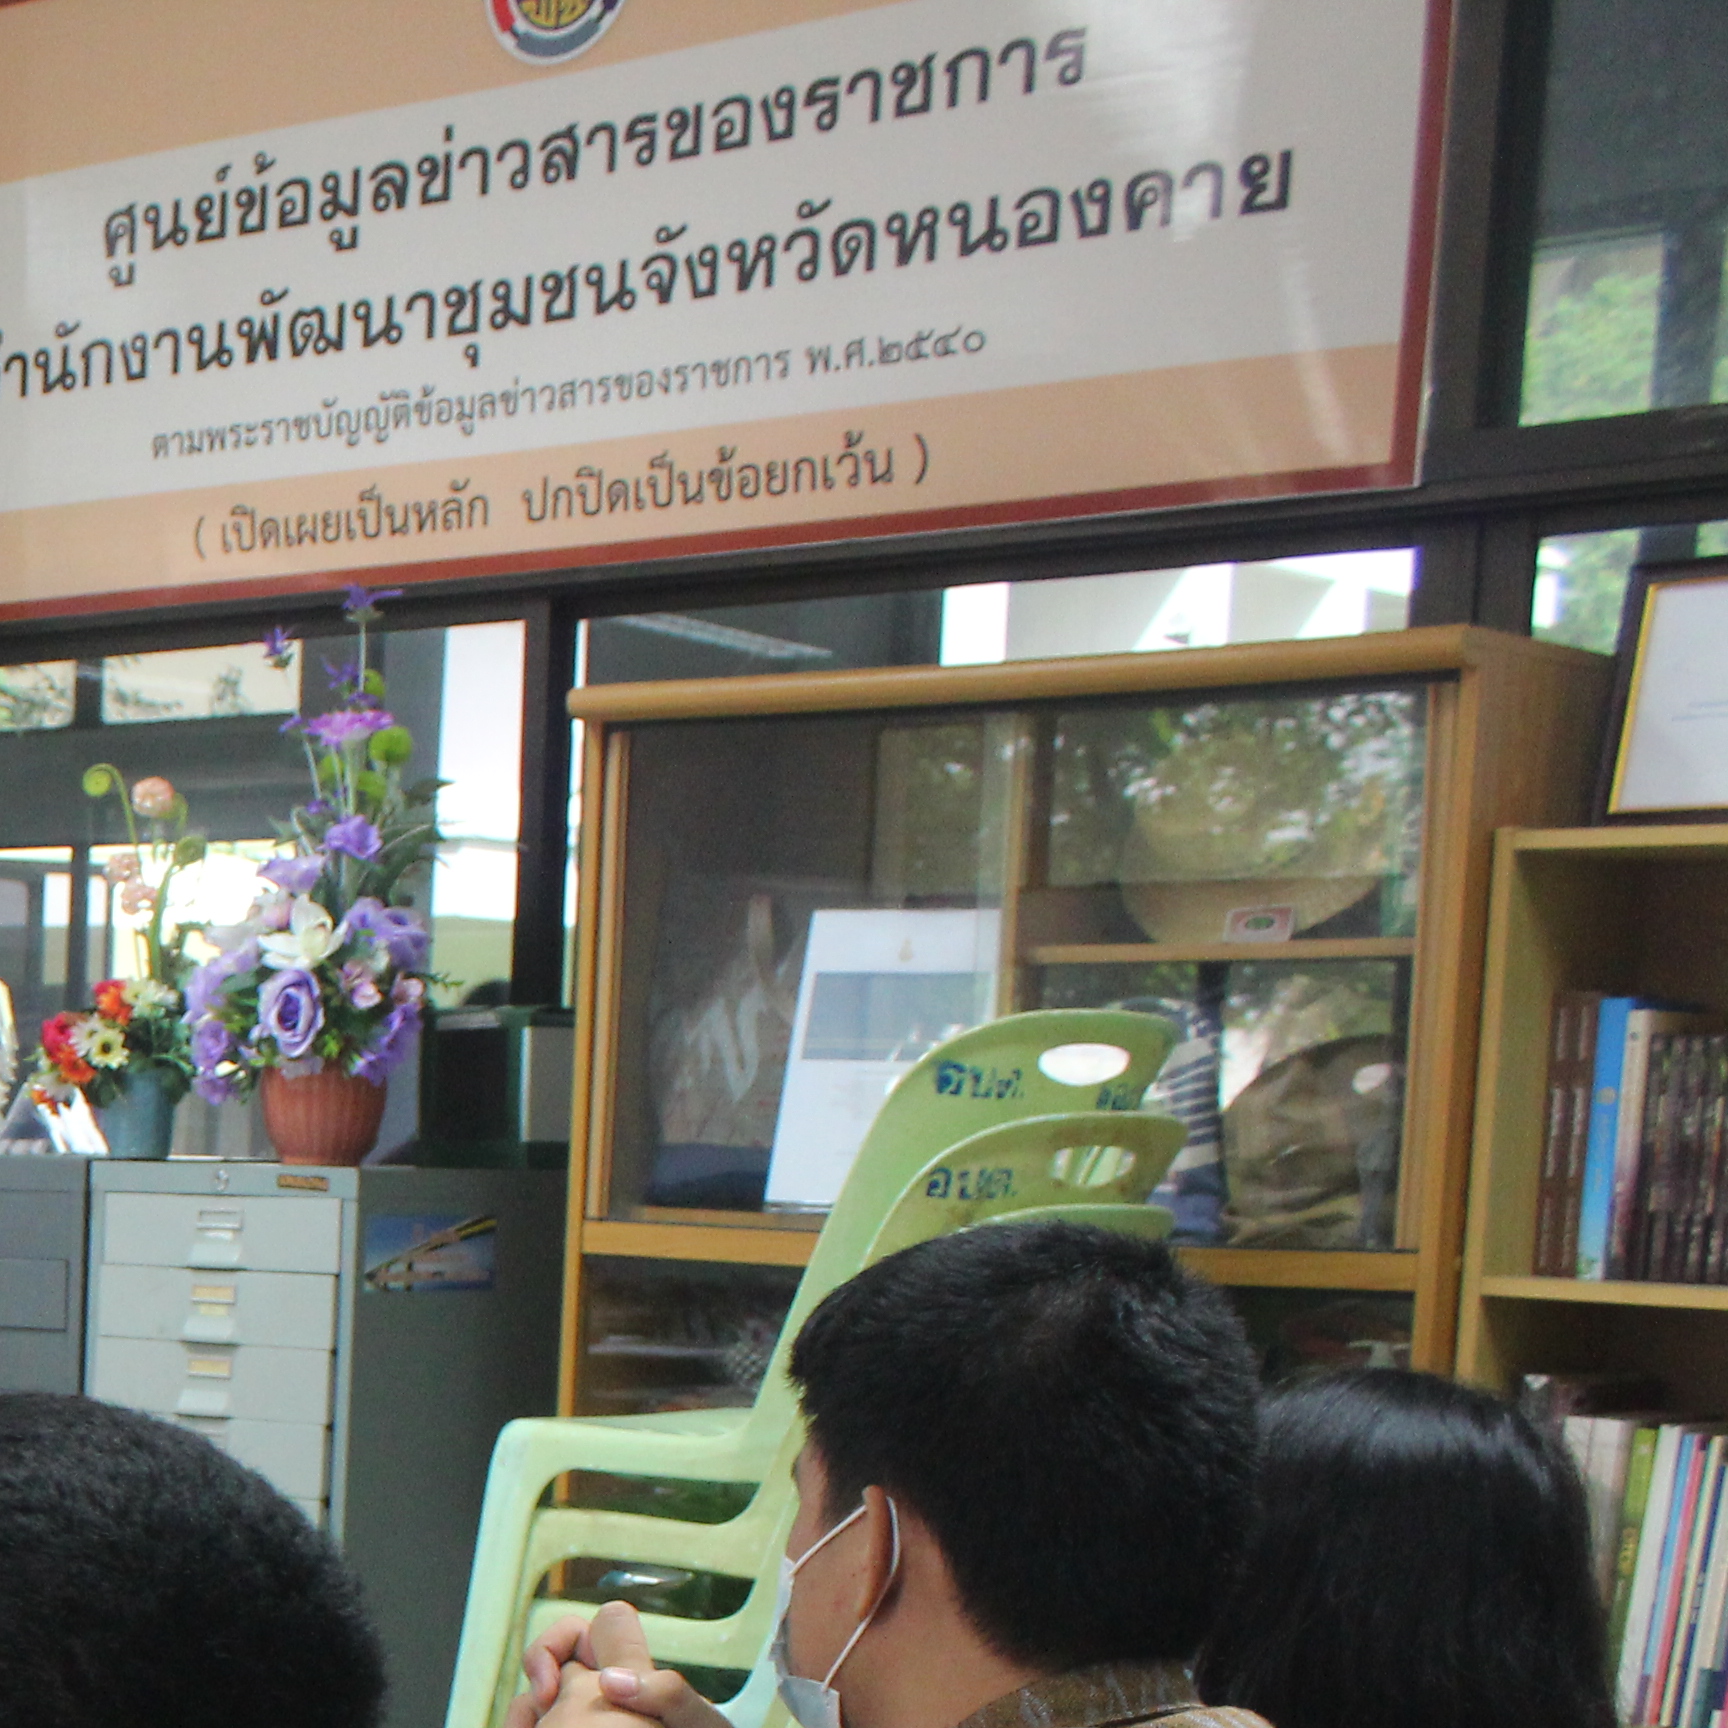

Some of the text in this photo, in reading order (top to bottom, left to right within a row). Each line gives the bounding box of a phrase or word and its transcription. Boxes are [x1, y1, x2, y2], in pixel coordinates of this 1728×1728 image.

[102, 25, 1090, 287] ศูนย์ข้อมูลข่าวสารของราชการ
[151, 323, 989, 460] ตามพระราชบัญญัติข้อมูลข่าวสารของราชการ พ.ศ.๒๕๔๐
